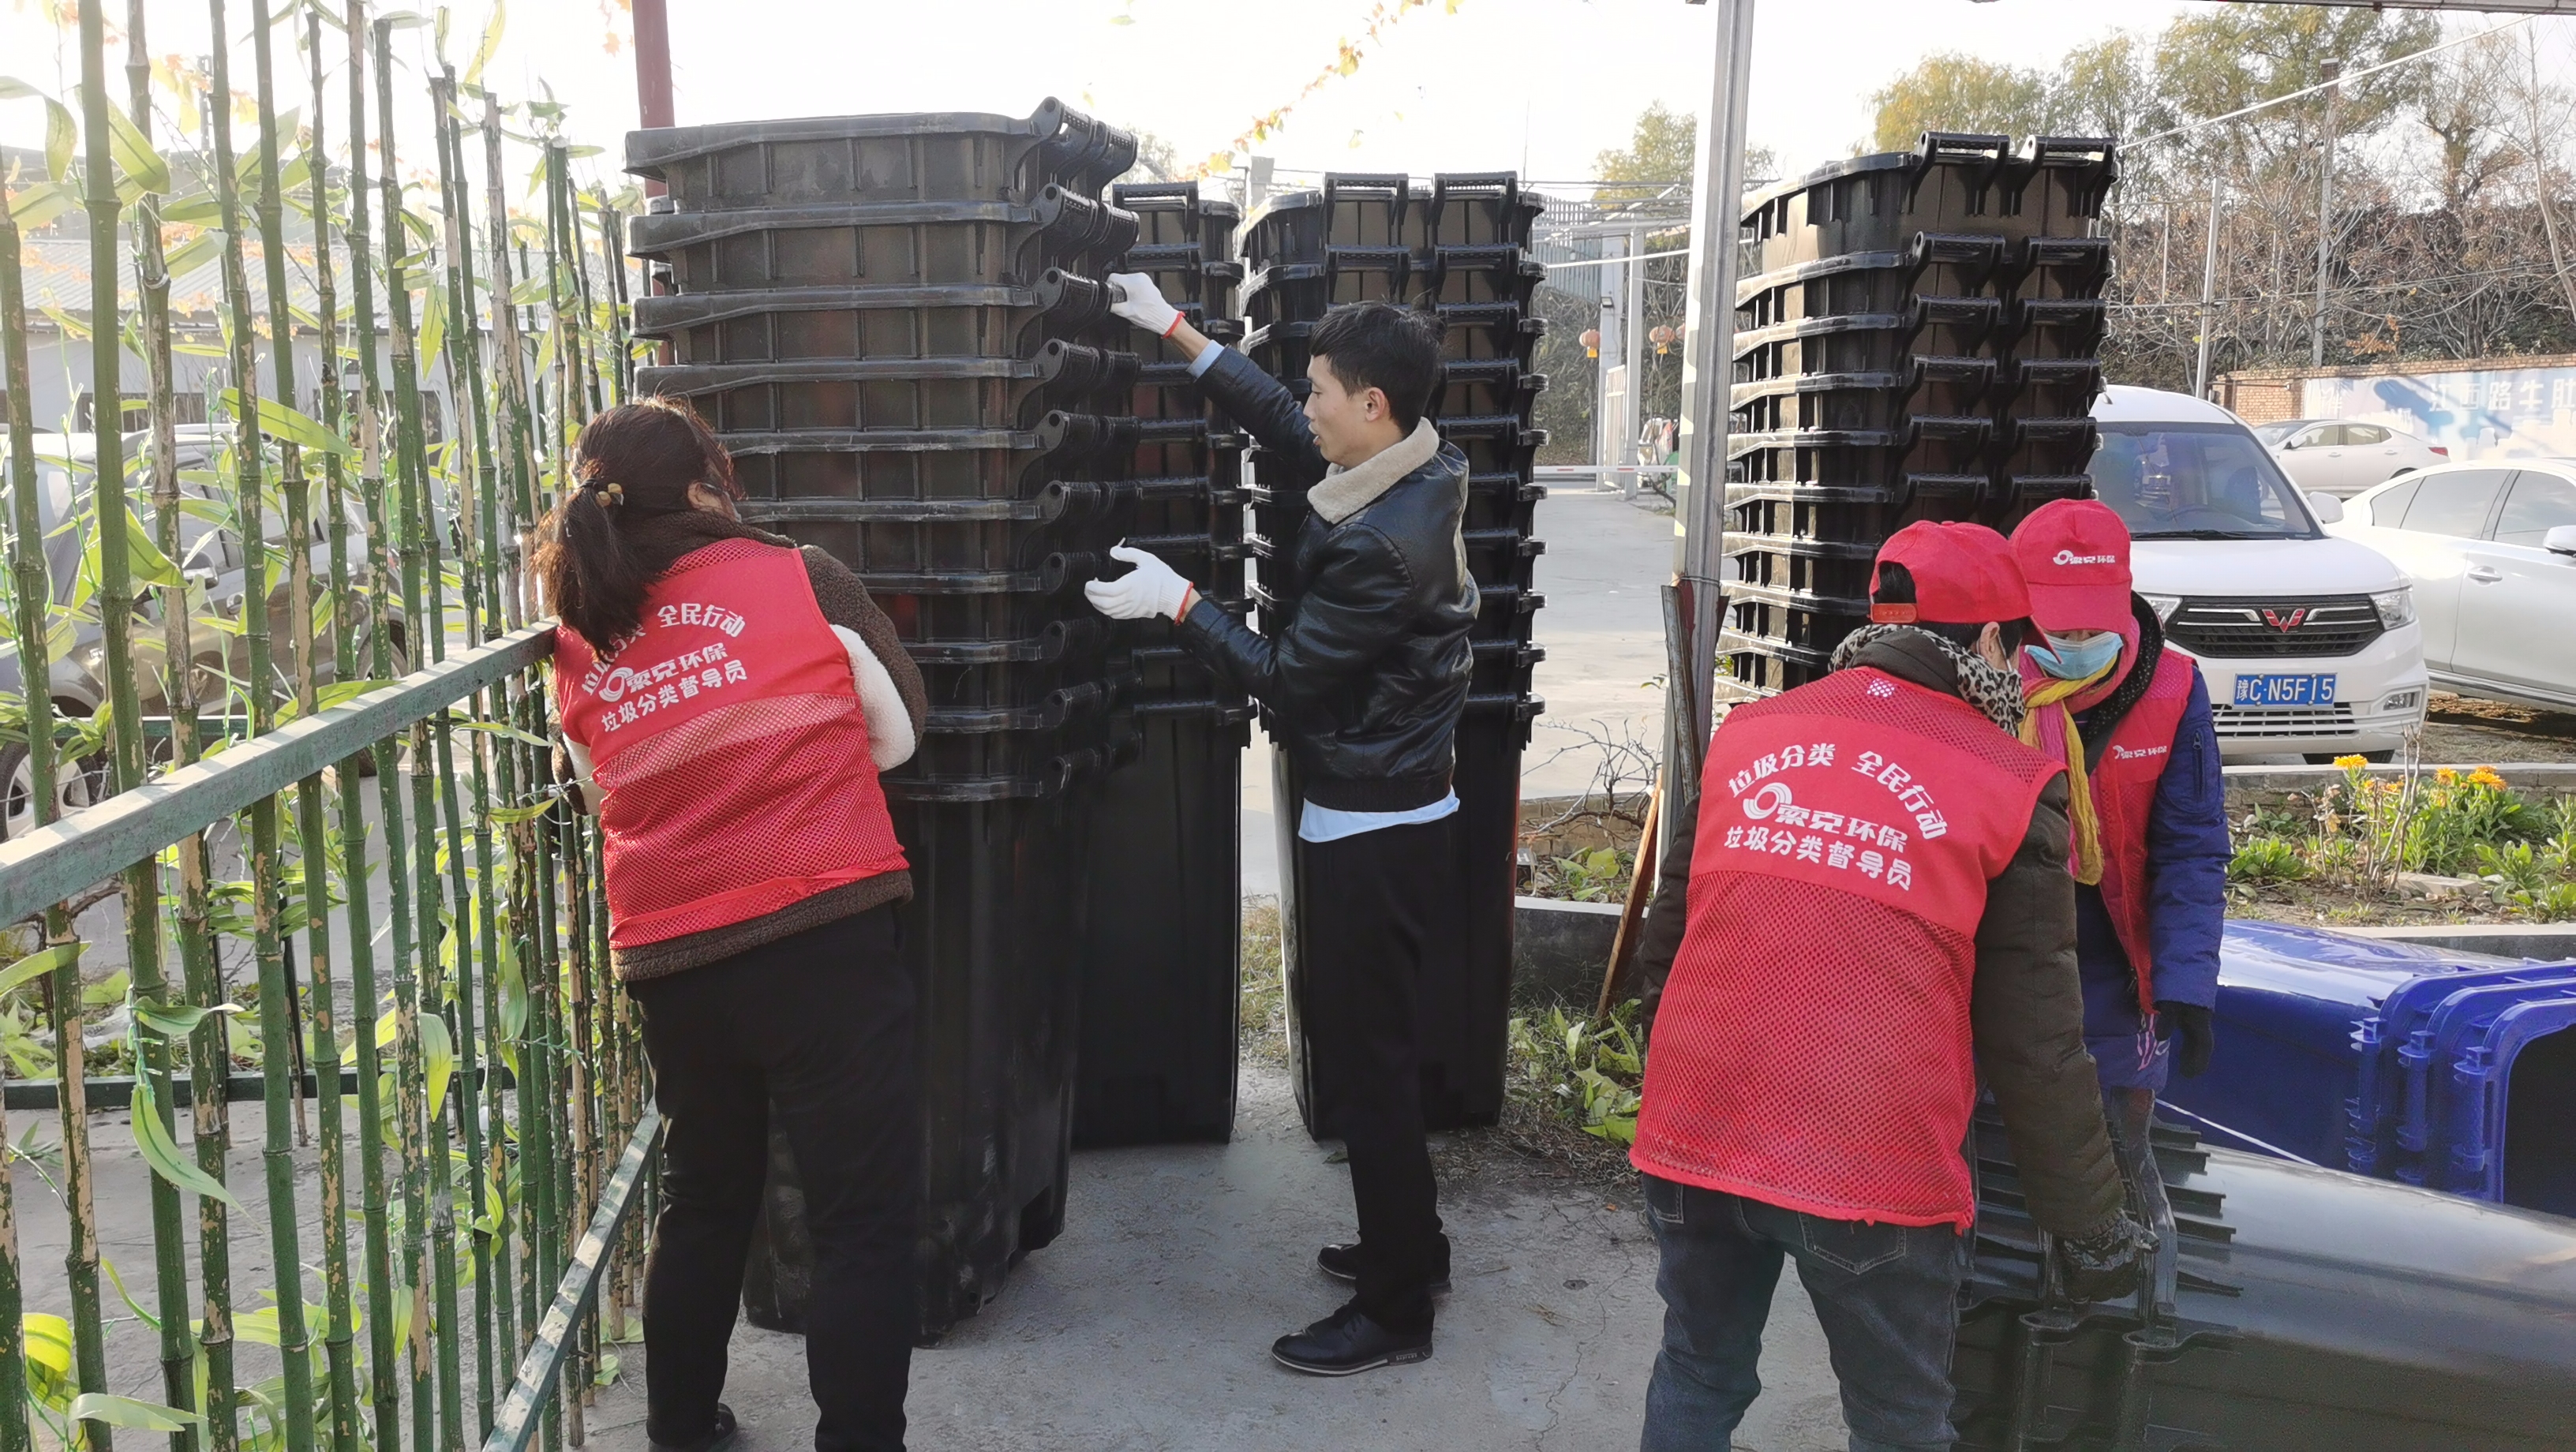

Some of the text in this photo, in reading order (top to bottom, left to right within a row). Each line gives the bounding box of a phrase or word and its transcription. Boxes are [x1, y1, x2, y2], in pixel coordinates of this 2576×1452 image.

[657, 603, 747, 638] 全民行动
[601, 660, 747, 732] 垃圾分类督导员
[626, 642, 728, 694] 索克环保
[1728, 743, 1948, 840] 垃圾分类 全民行动
[1724, 825, 1912, 892] 垃圾分类督导员
[1775, 804, 1908, 854] 索克环保
